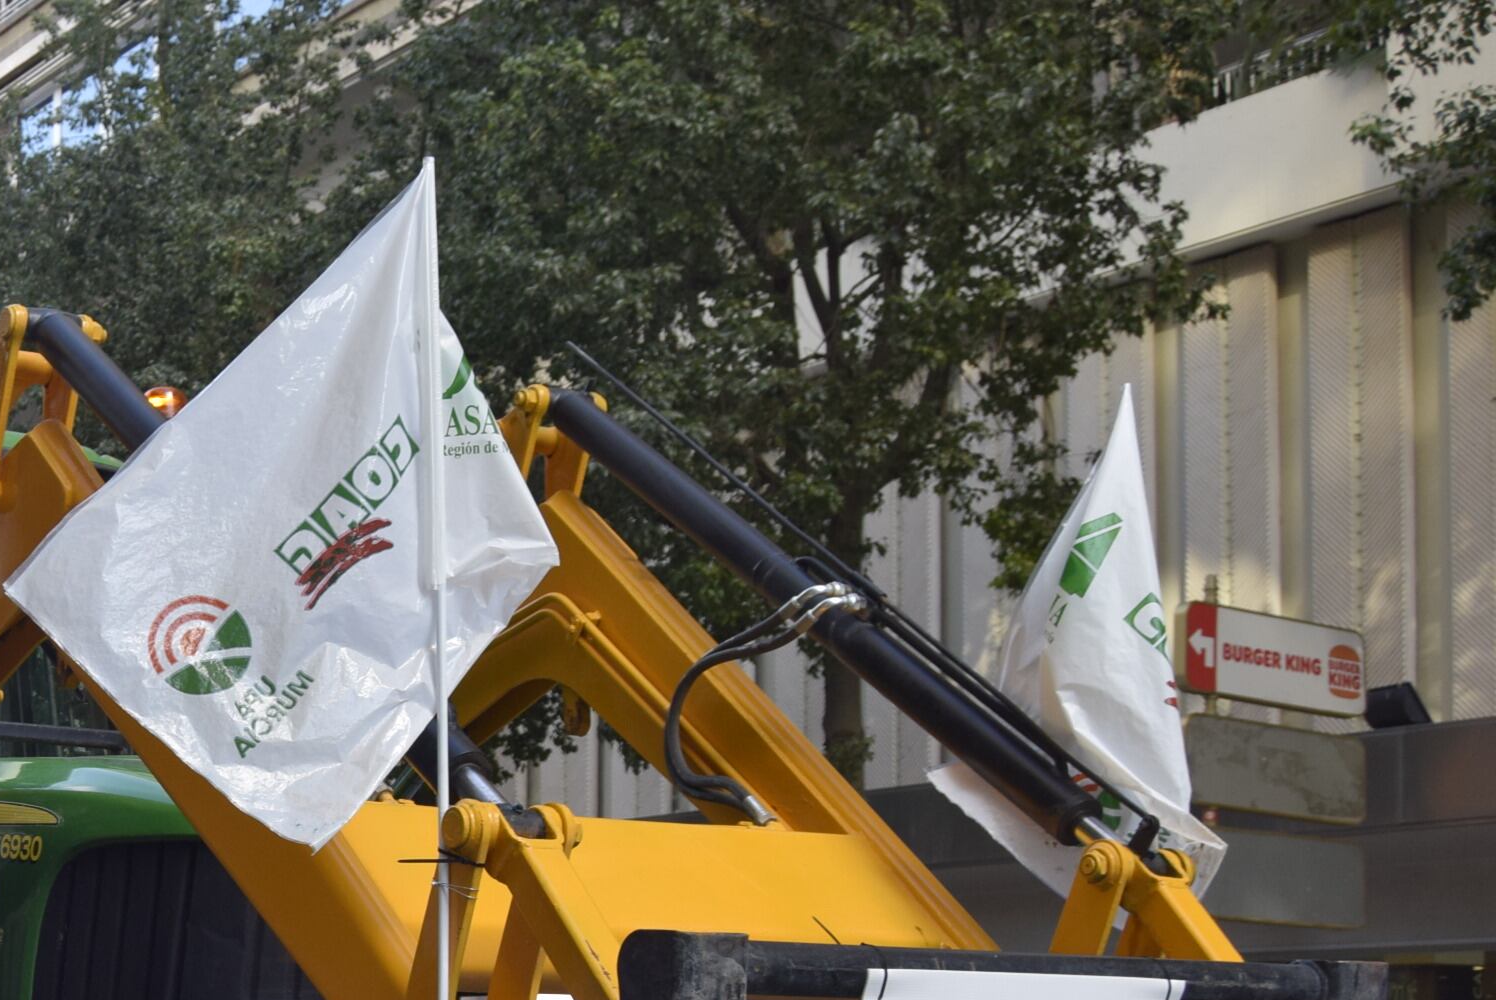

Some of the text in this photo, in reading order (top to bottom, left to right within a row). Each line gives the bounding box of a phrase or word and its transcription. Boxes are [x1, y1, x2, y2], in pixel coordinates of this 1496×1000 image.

[484, 441, 498, 454] de
[1223, 643, 1322, 676] BURGER KING
[1328, 659, 1361, 675] BURGER
[1328, 671, 1361, 690] KING
[0, 834, 42, 862] 6930
